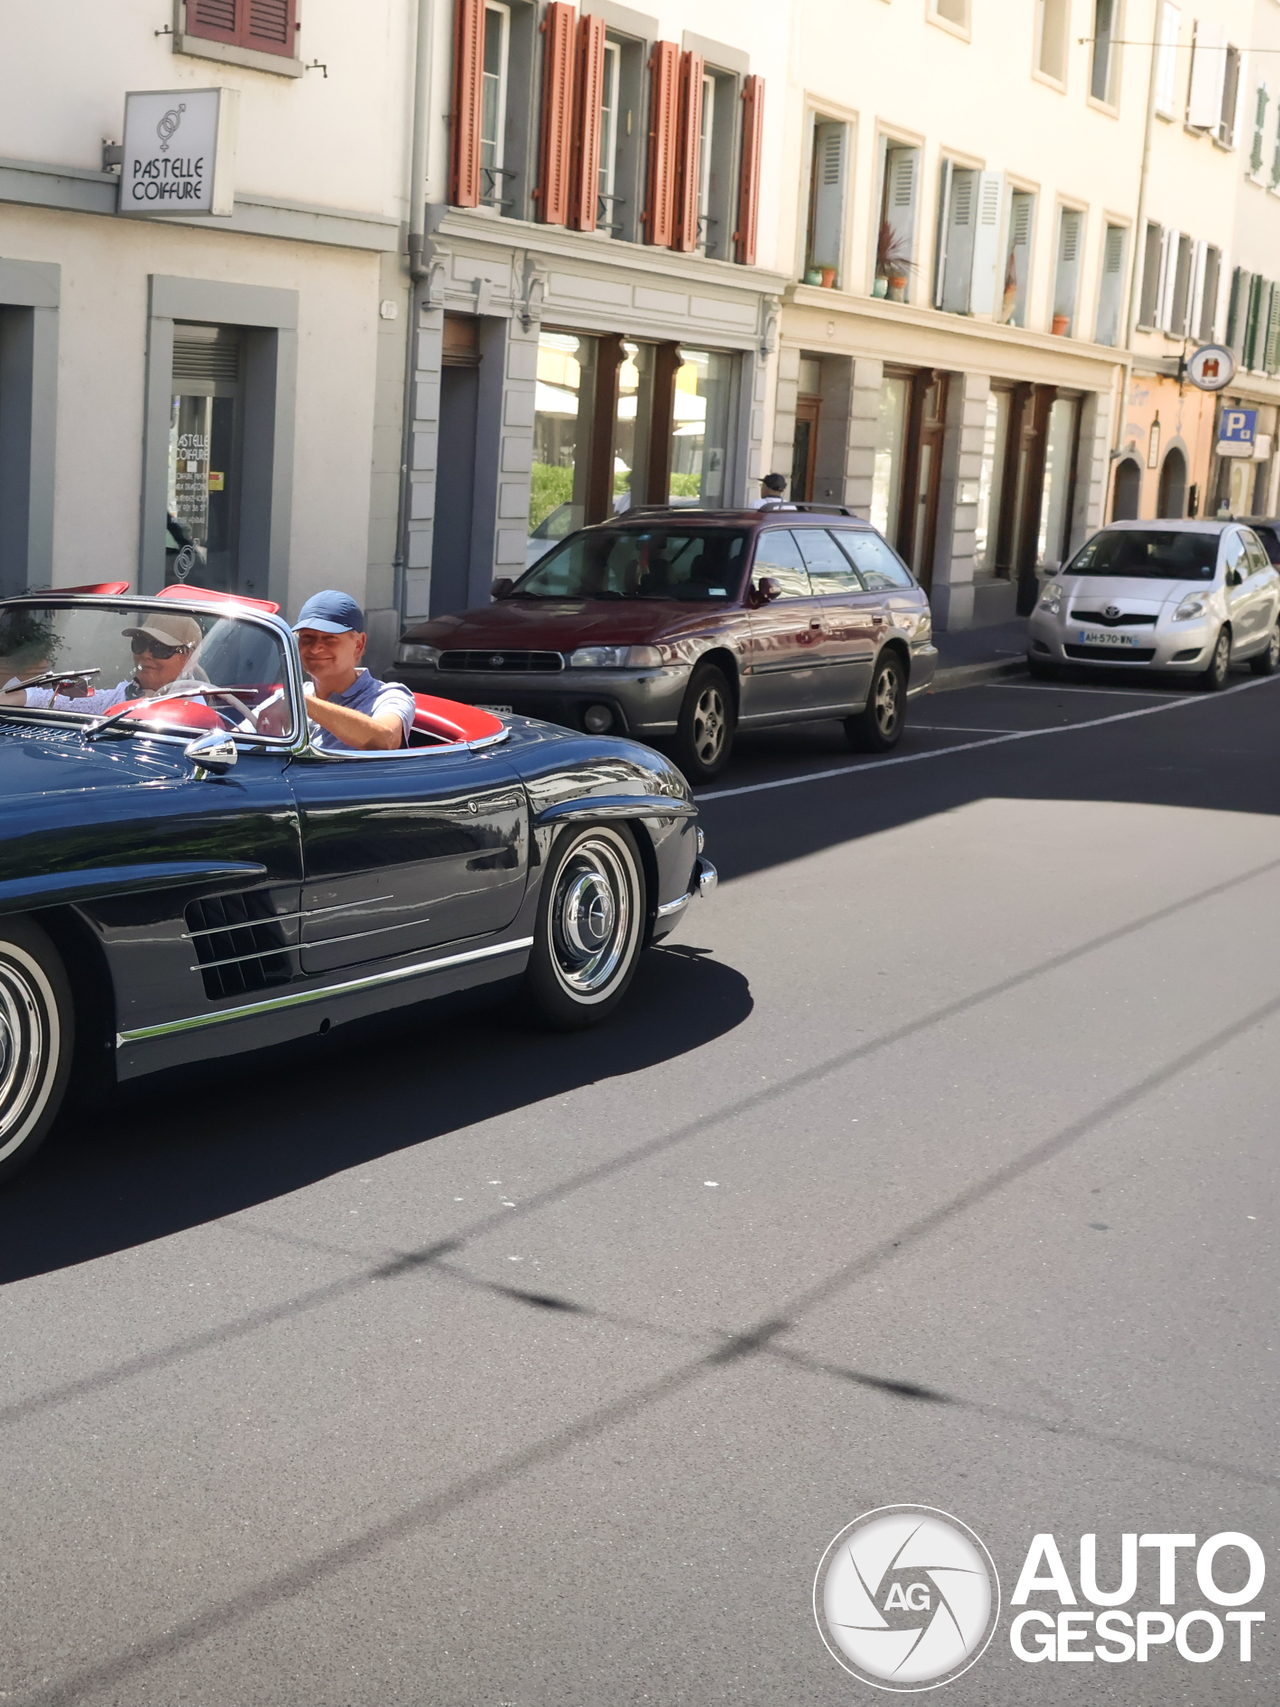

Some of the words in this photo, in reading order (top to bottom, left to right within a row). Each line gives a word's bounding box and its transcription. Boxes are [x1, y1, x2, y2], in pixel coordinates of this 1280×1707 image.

[133, 157, 203, 179] PASTELLE
[132, 180, 202, 200] COIFFURE
[1226, 412, 1246, 437] P
